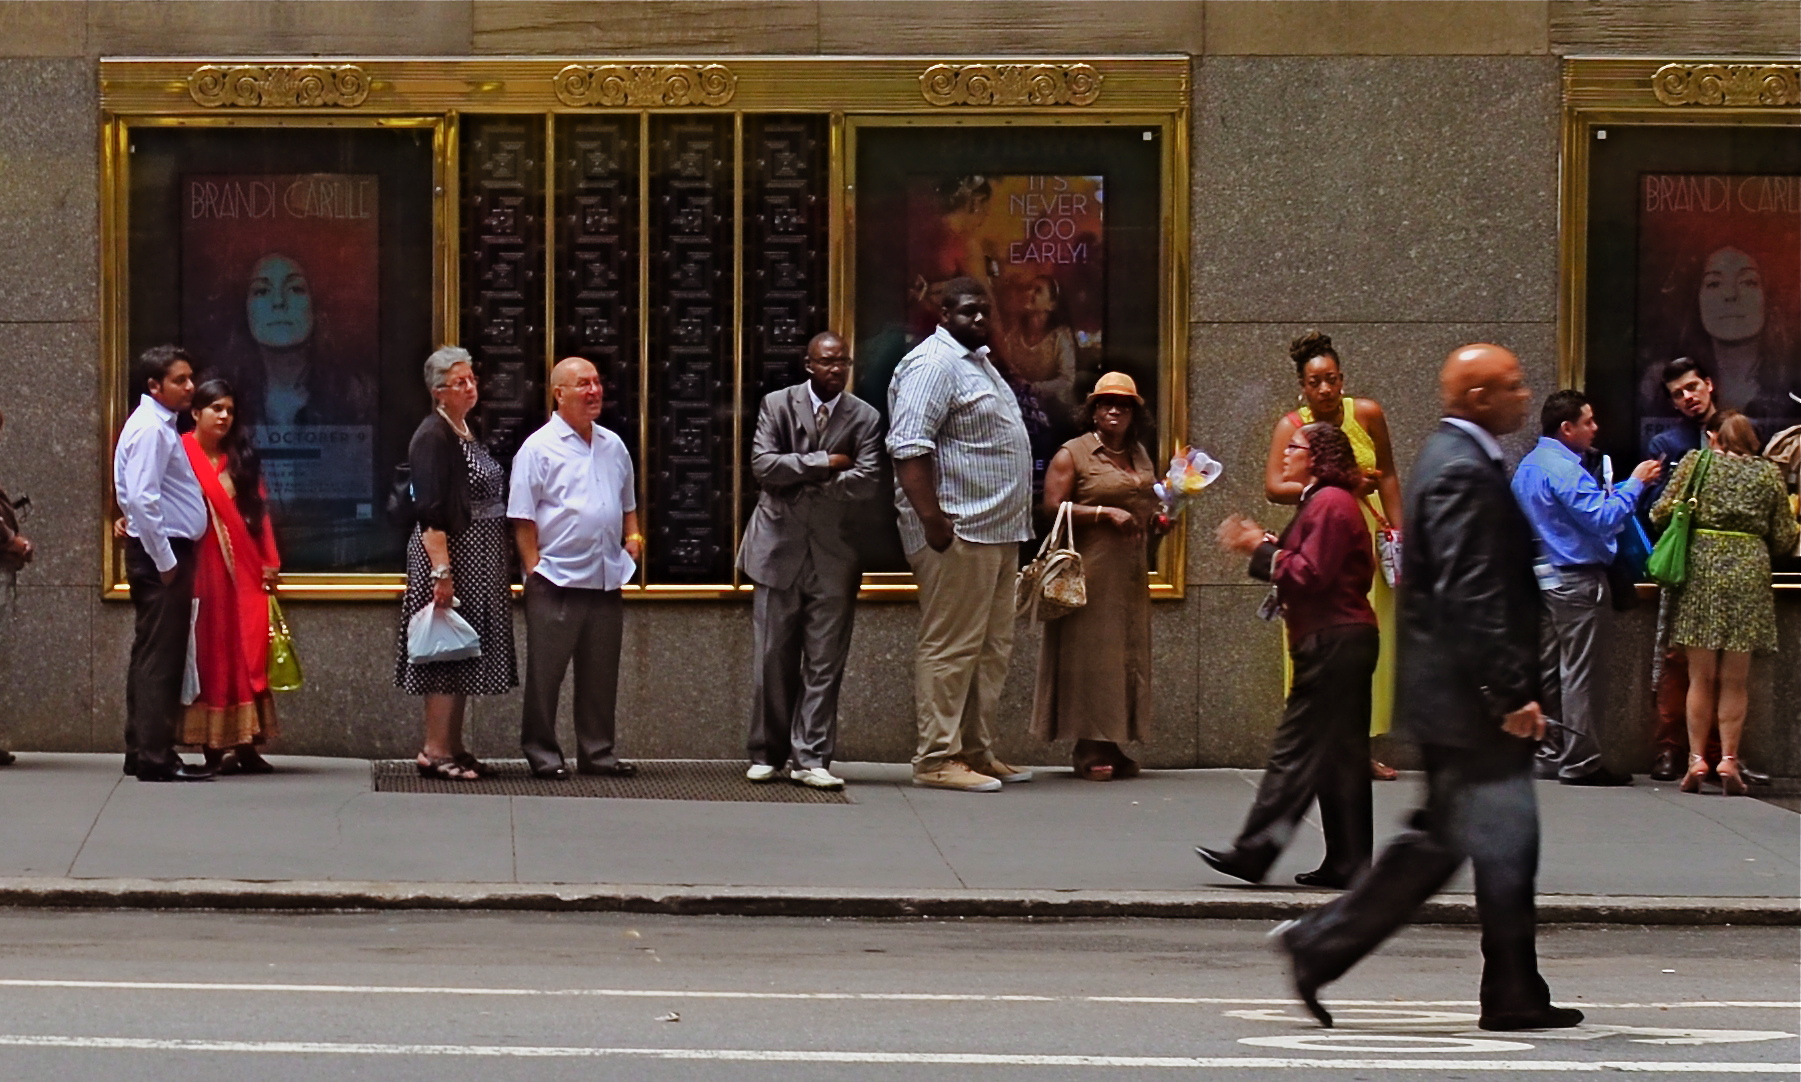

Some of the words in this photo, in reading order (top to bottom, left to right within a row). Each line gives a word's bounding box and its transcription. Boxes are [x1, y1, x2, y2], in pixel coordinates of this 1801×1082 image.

[192, 181, 276, 219] BRANDI
[283, 181, 371, 219] CARLILE
[1010, 193, 1087, 216] NEVER
[1646, 175, 1731, 213] BRANDI
[1021, 217, 1076, 240] TOO
[1010, 242, 1087, 264] EARLY!
[268, 431, 349, 444] OCTOBER
[357, 431, 366, 443] 9
